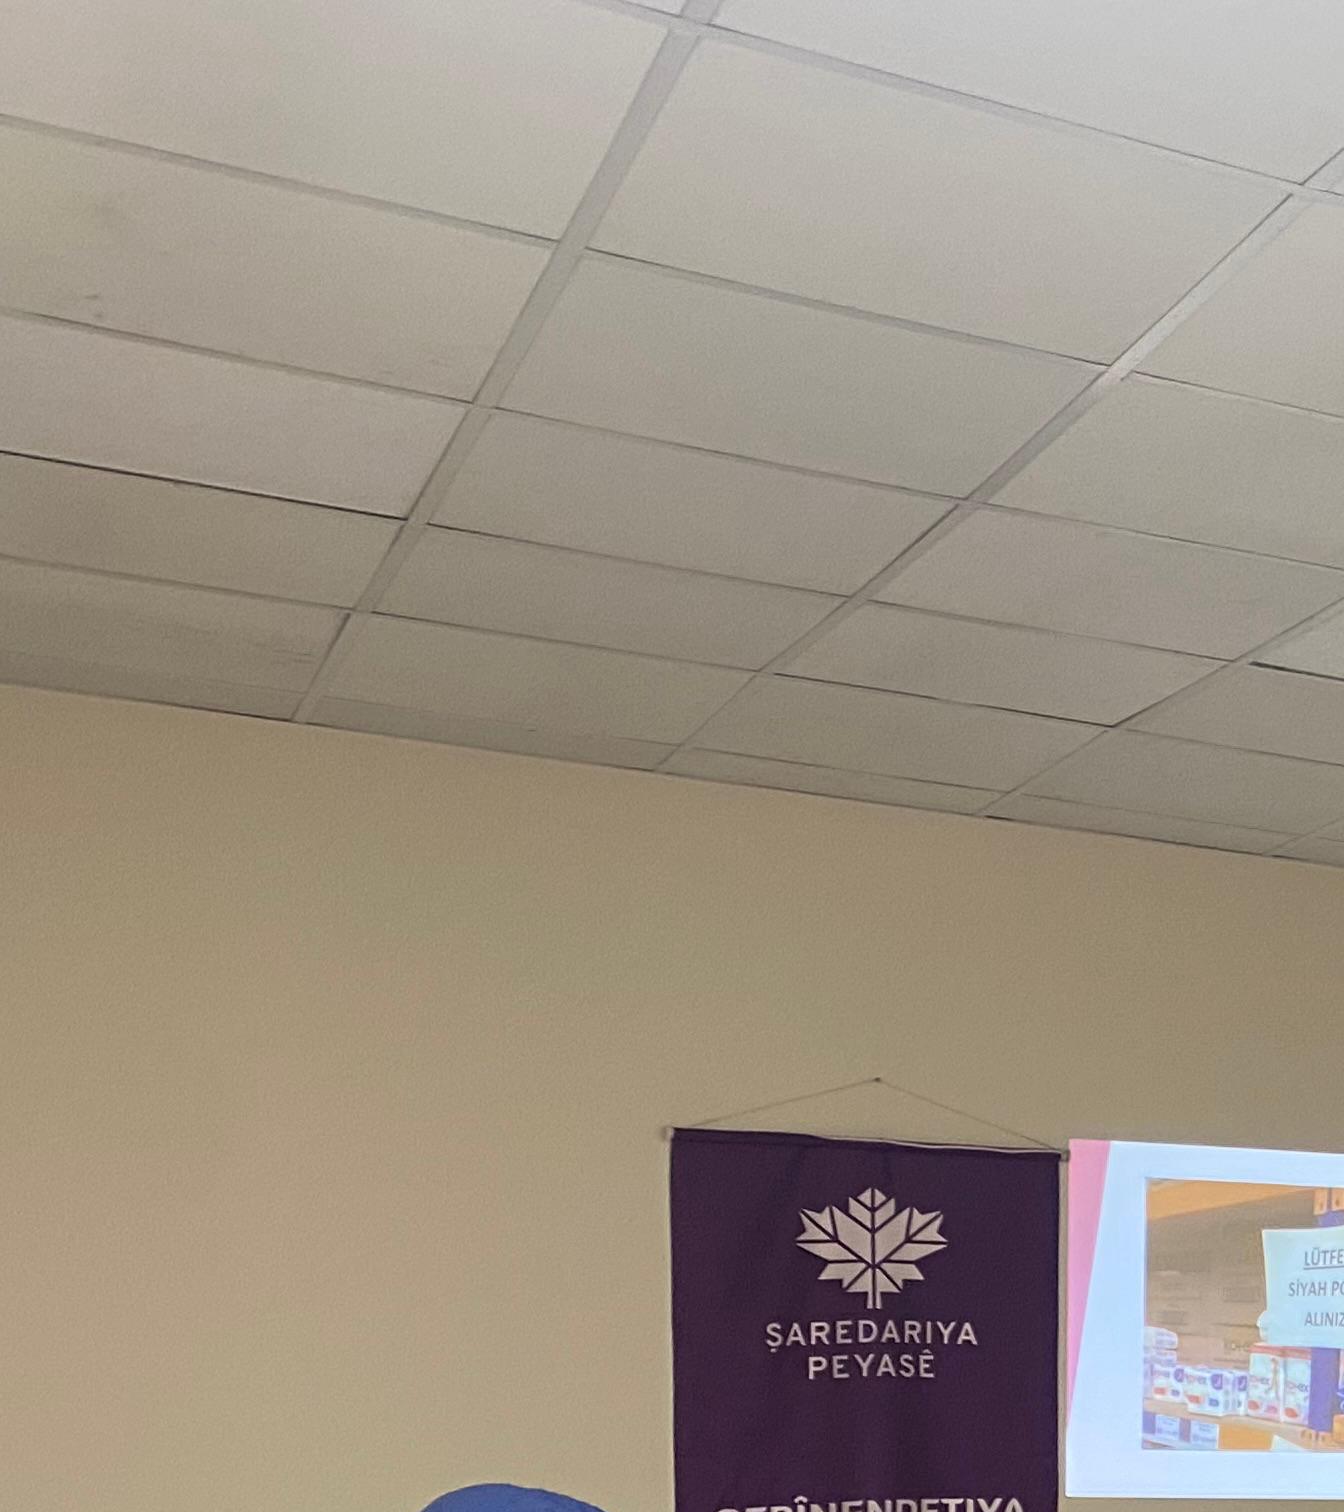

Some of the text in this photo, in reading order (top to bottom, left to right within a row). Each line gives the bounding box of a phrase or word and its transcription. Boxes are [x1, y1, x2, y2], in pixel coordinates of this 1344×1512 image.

[1288, 1278, 1327, 1297] SİYAH
[765, 1319, 978, 1353] ŞAREDARIYA
[808, 1349, 935, 1380] PEYASÊ
